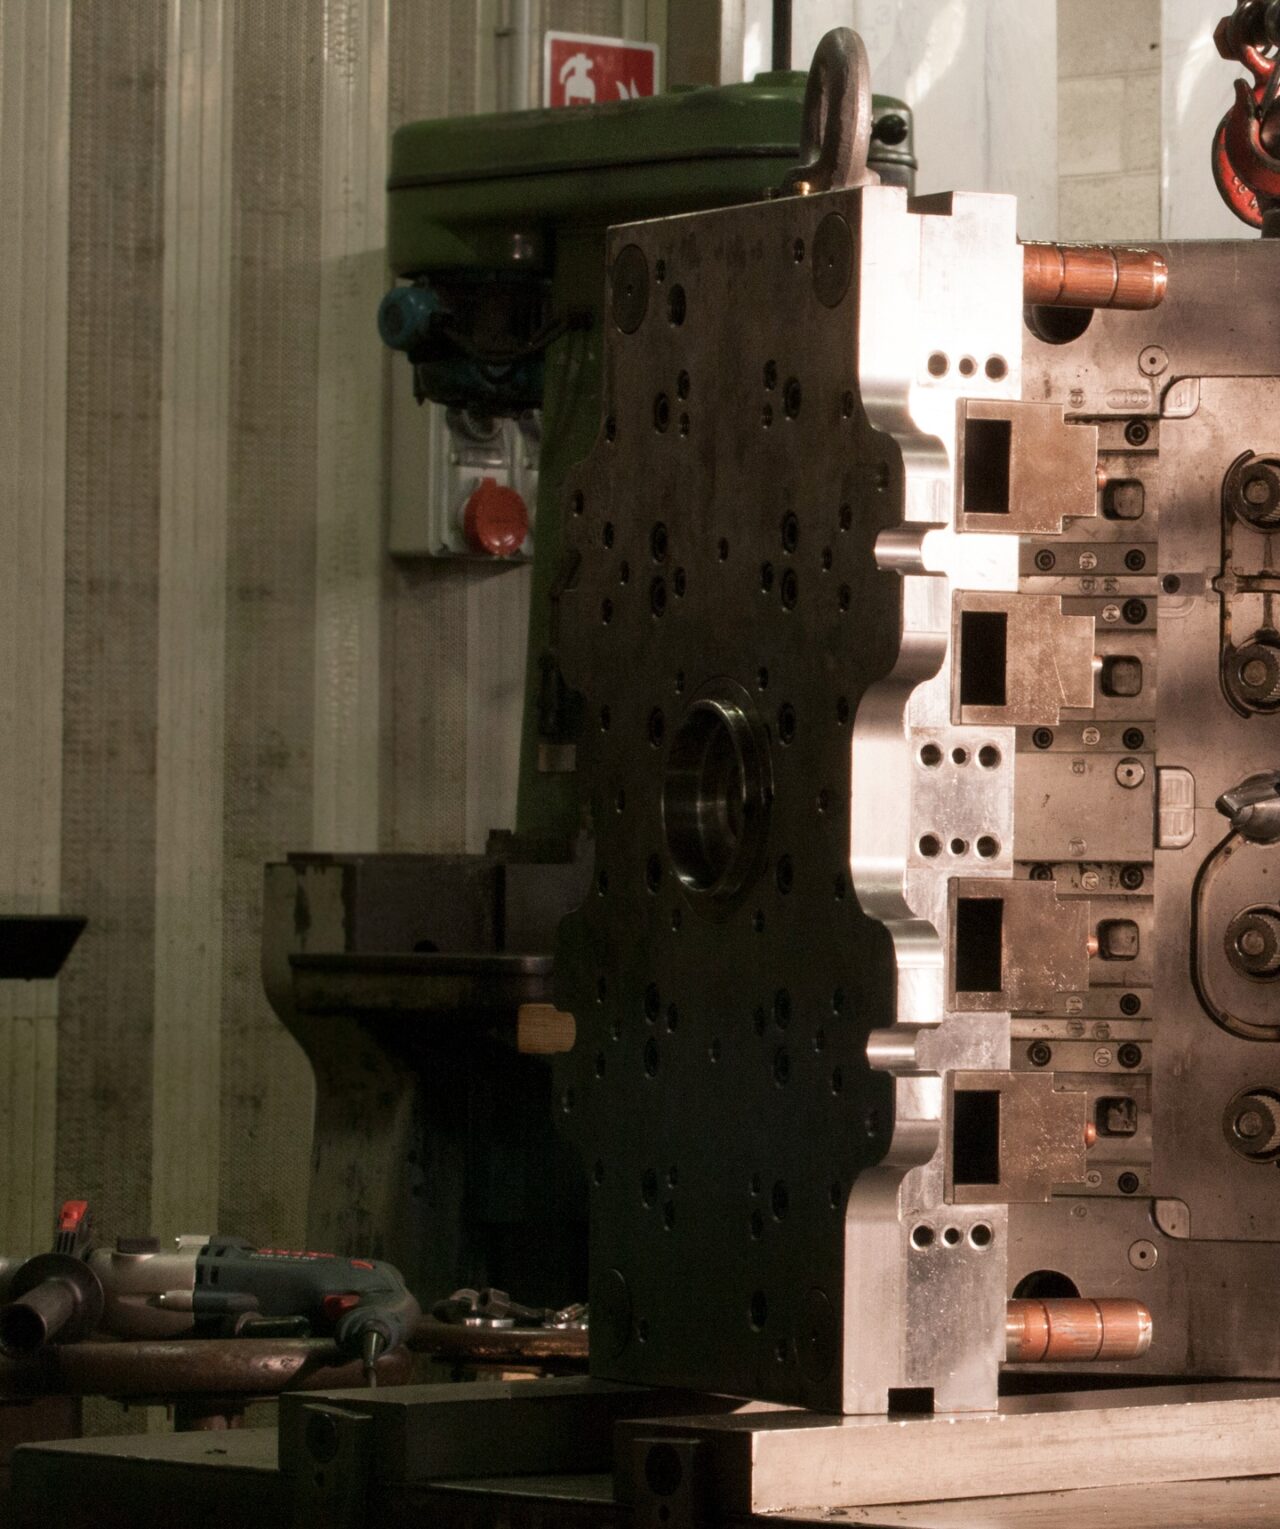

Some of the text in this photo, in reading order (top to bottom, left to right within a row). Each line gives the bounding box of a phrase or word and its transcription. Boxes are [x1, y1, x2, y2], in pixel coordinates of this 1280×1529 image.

[1105, 607, 1117, 620] 14
[1085, 729, 1098, 743] 13
[1072, 759, 1086, 774] 13
[1084, 874, 1097, 888] 12
[1097, 1051, 1110, 1065] 10
